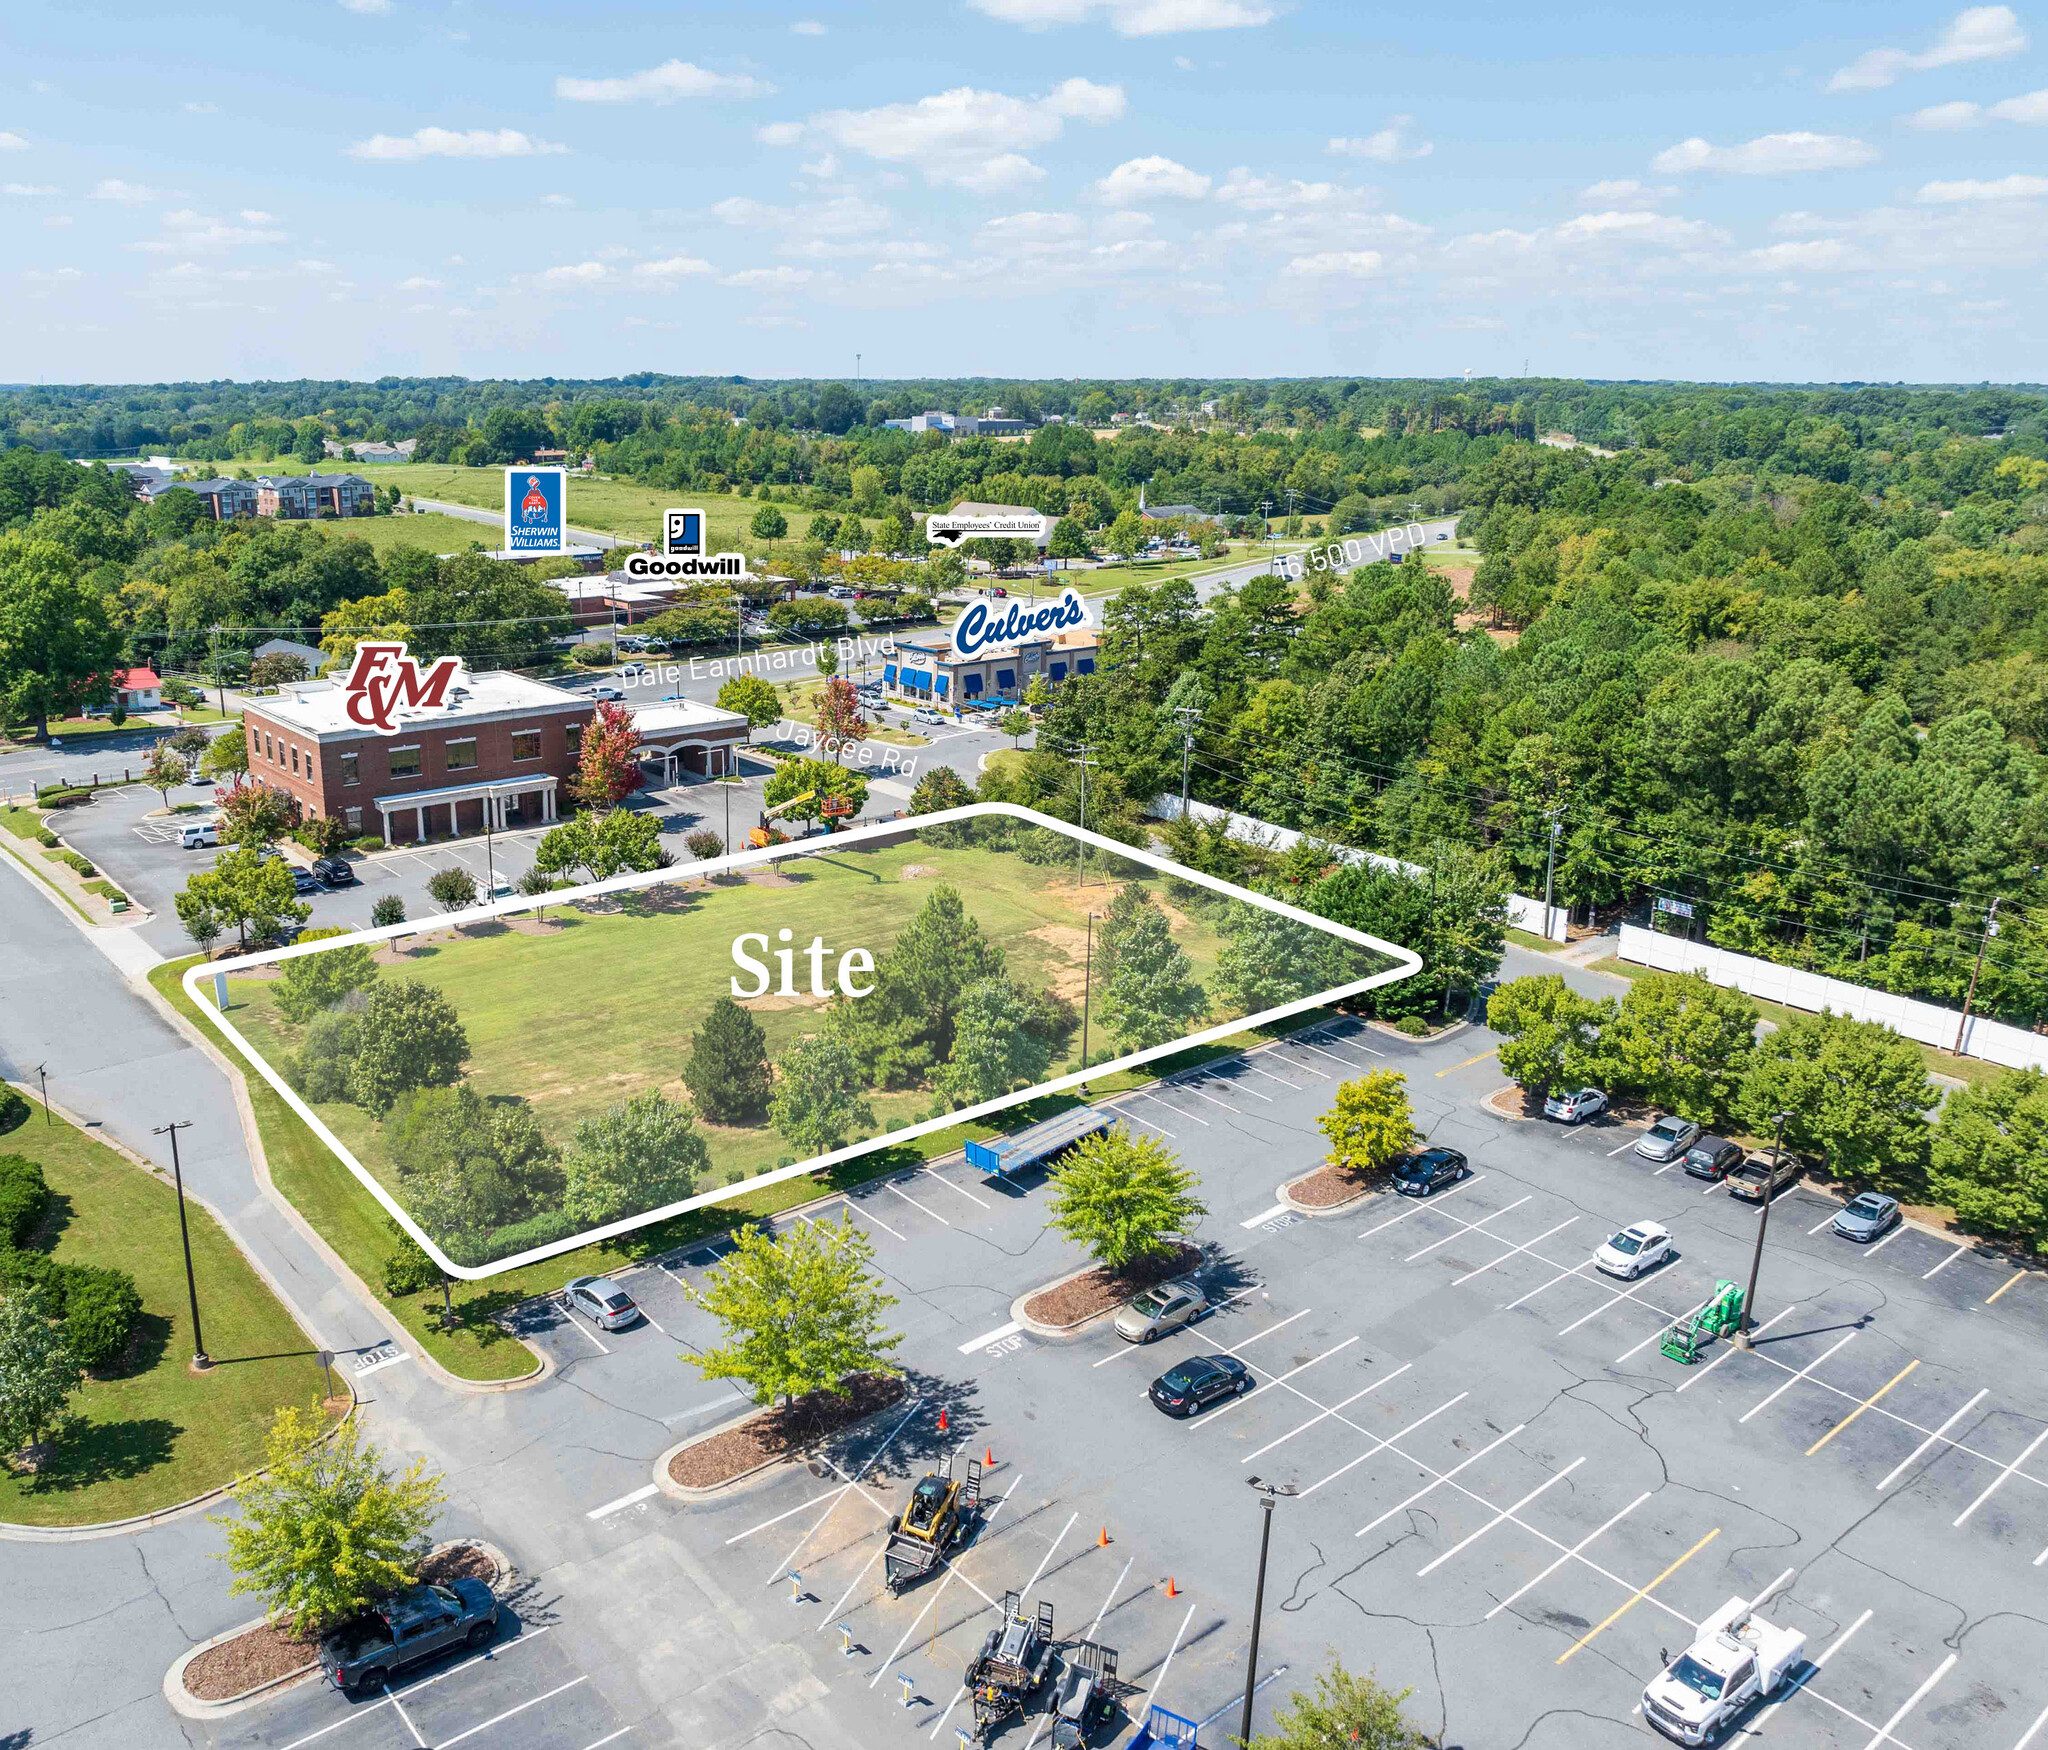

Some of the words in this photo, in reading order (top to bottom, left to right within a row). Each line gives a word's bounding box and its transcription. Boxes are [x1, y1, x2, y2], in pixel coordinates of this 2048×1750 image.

[1262, 1215, 1293, 1233] STOP
[354, 1346, 399, 1370] STOP
[985, 1334, 1023, 1358] STOP
